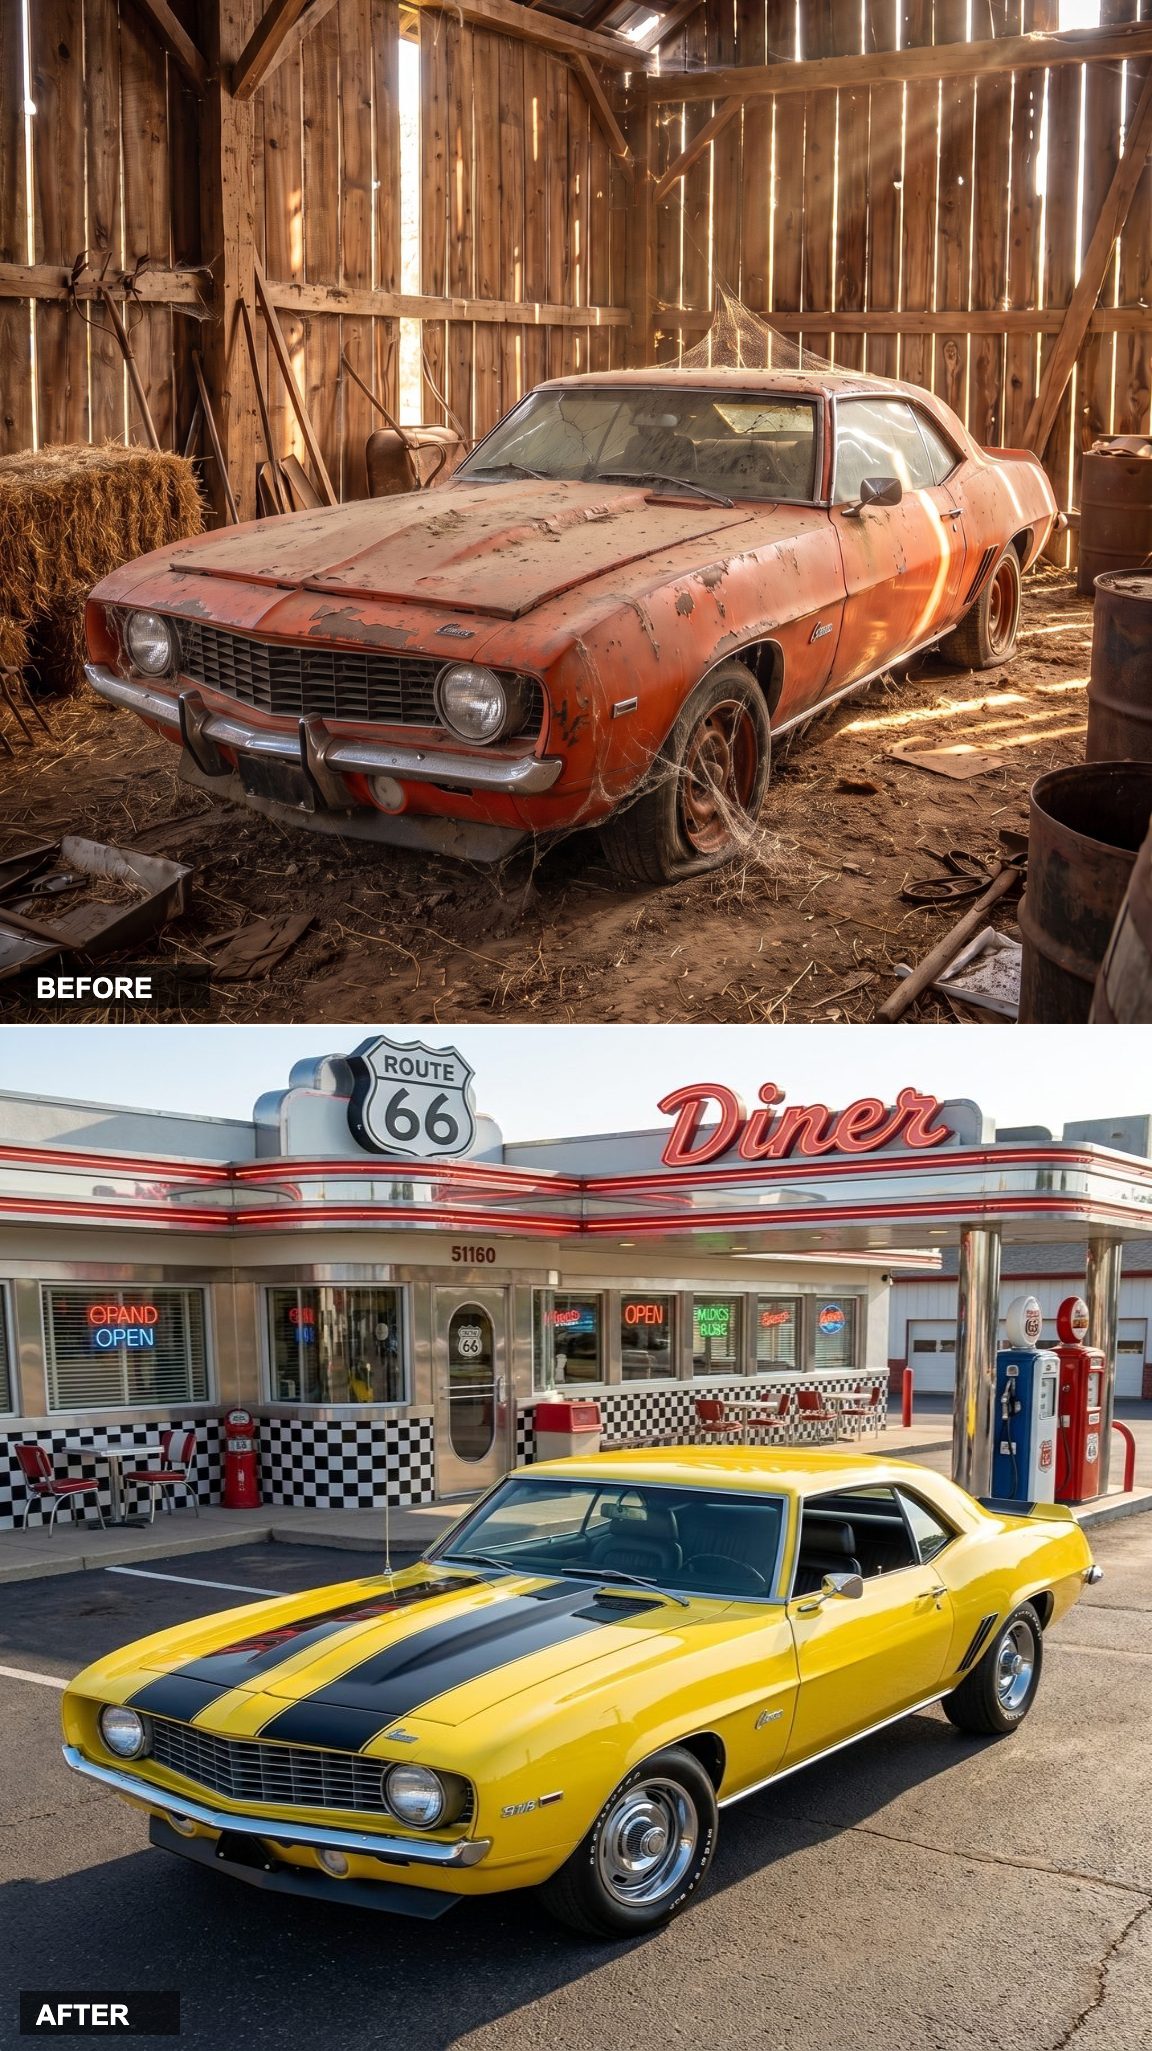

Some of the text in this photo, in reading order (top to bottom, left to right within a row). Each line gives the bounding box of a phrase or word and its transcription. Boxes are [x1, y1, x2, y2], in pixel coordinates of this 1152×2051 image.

[384, 1055, 455, 1081] ROUTE
[385, 1087, 459, 1146] 66
[657, 1082, 953, 1168] Diner
[451, 1245, 496, 1263] 51160
[89, 1306, 158, 1324] OPAND
[624, 1305, 663, 1324] OPEN
[96, 1328, 154, 1347] OPEN
[463, 1339, 479, 1353] 66
